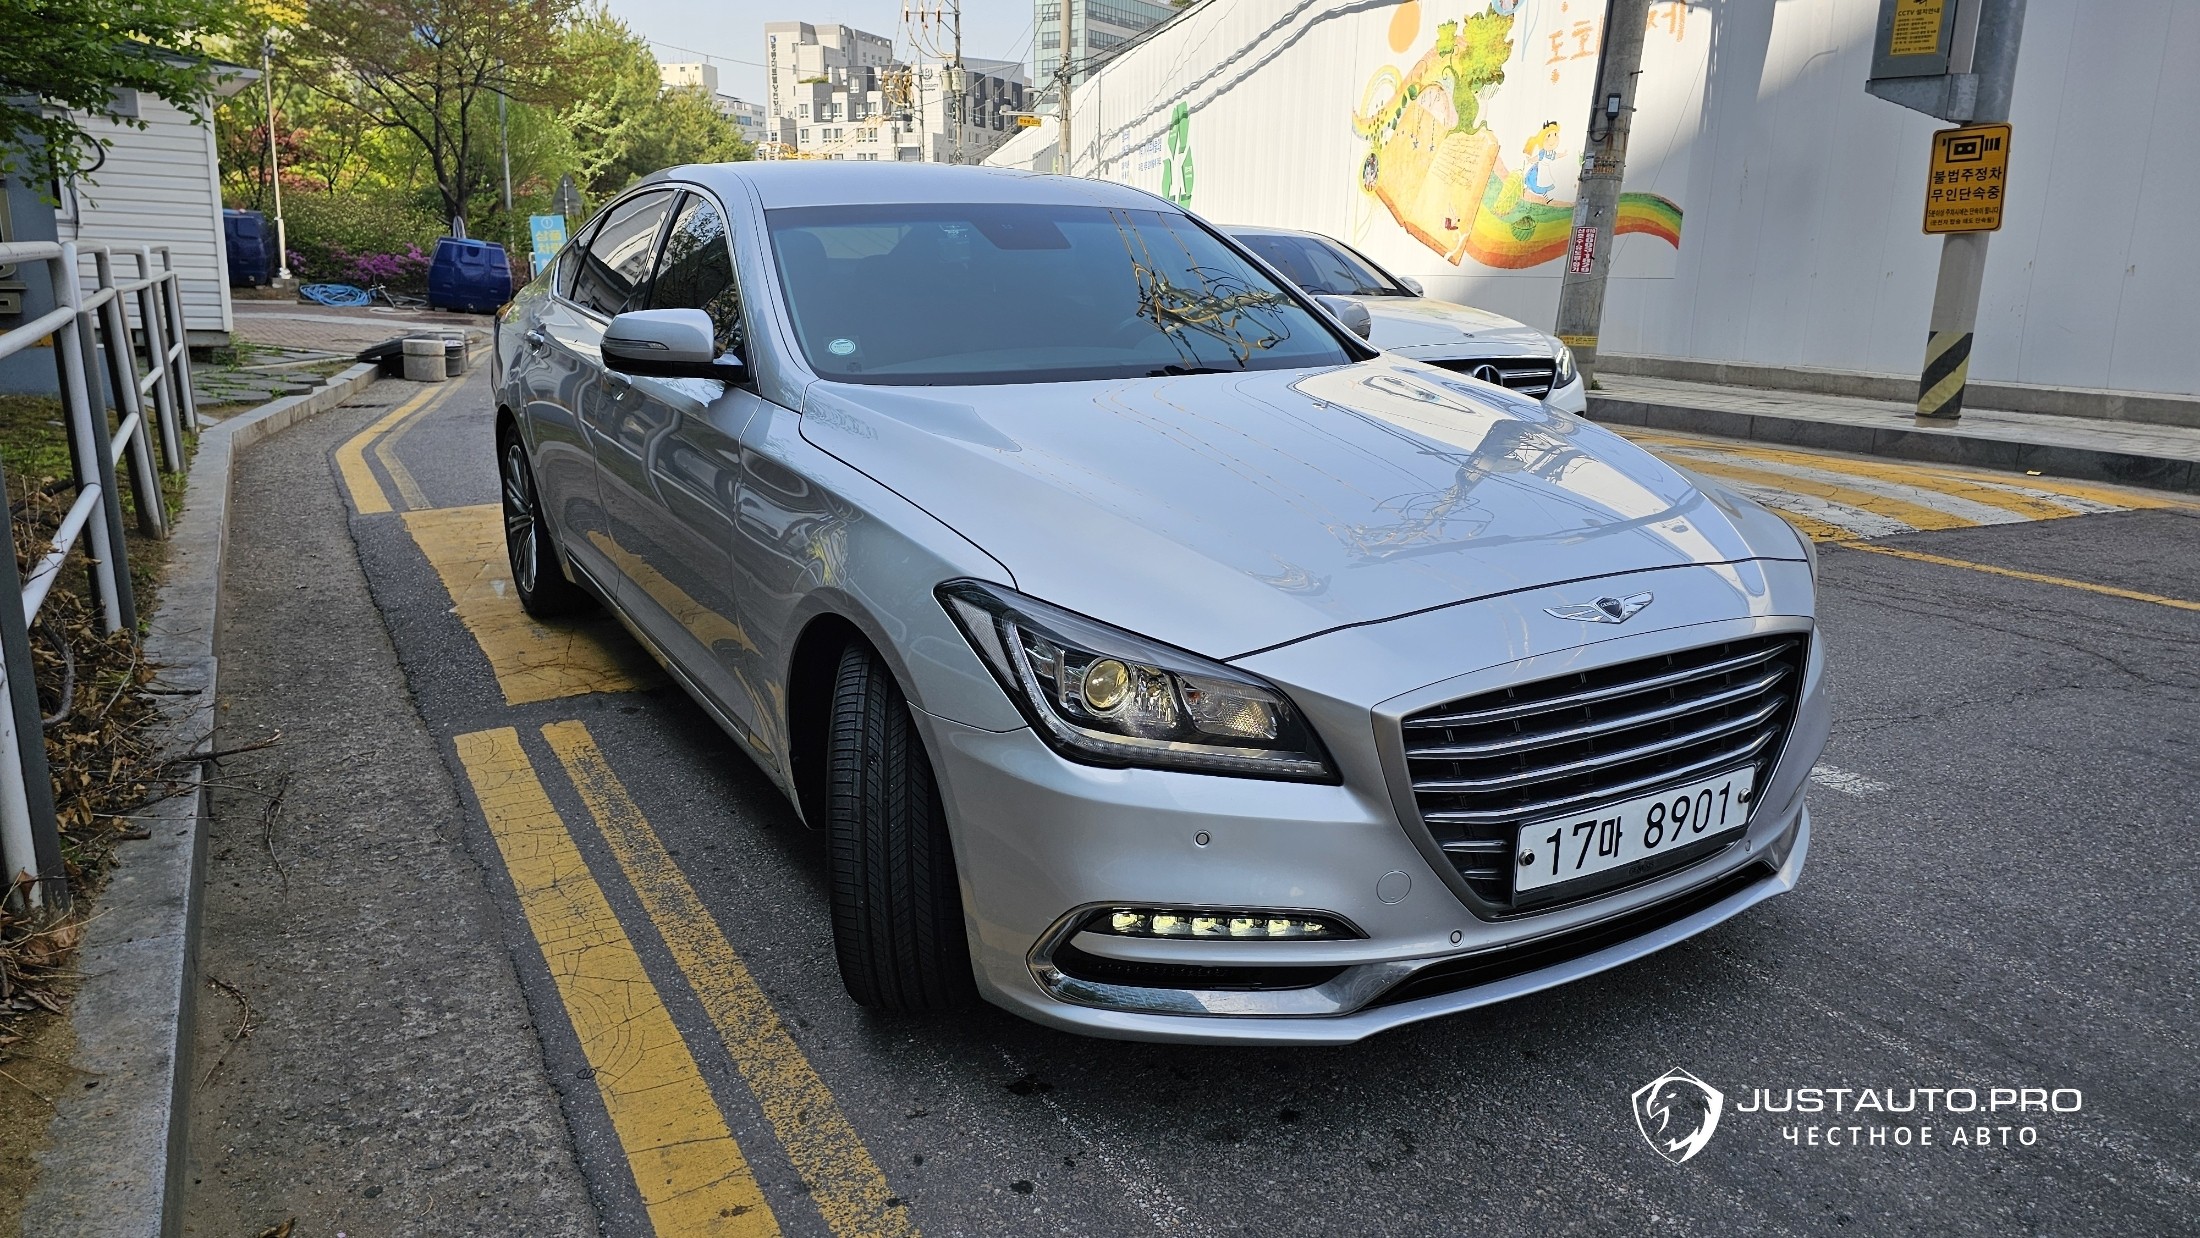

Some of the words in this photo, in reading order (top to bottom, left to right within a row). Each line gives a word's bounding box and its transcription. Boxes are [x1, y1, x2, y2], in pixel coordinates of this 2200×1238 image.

[1933, 166, 2002, 185] 불법주정차
[1931, 185, 2000, 202] 무인단속중
[1546, 815, 1623, 876] 17마
[1643, 780, 1731, 849] 8901
